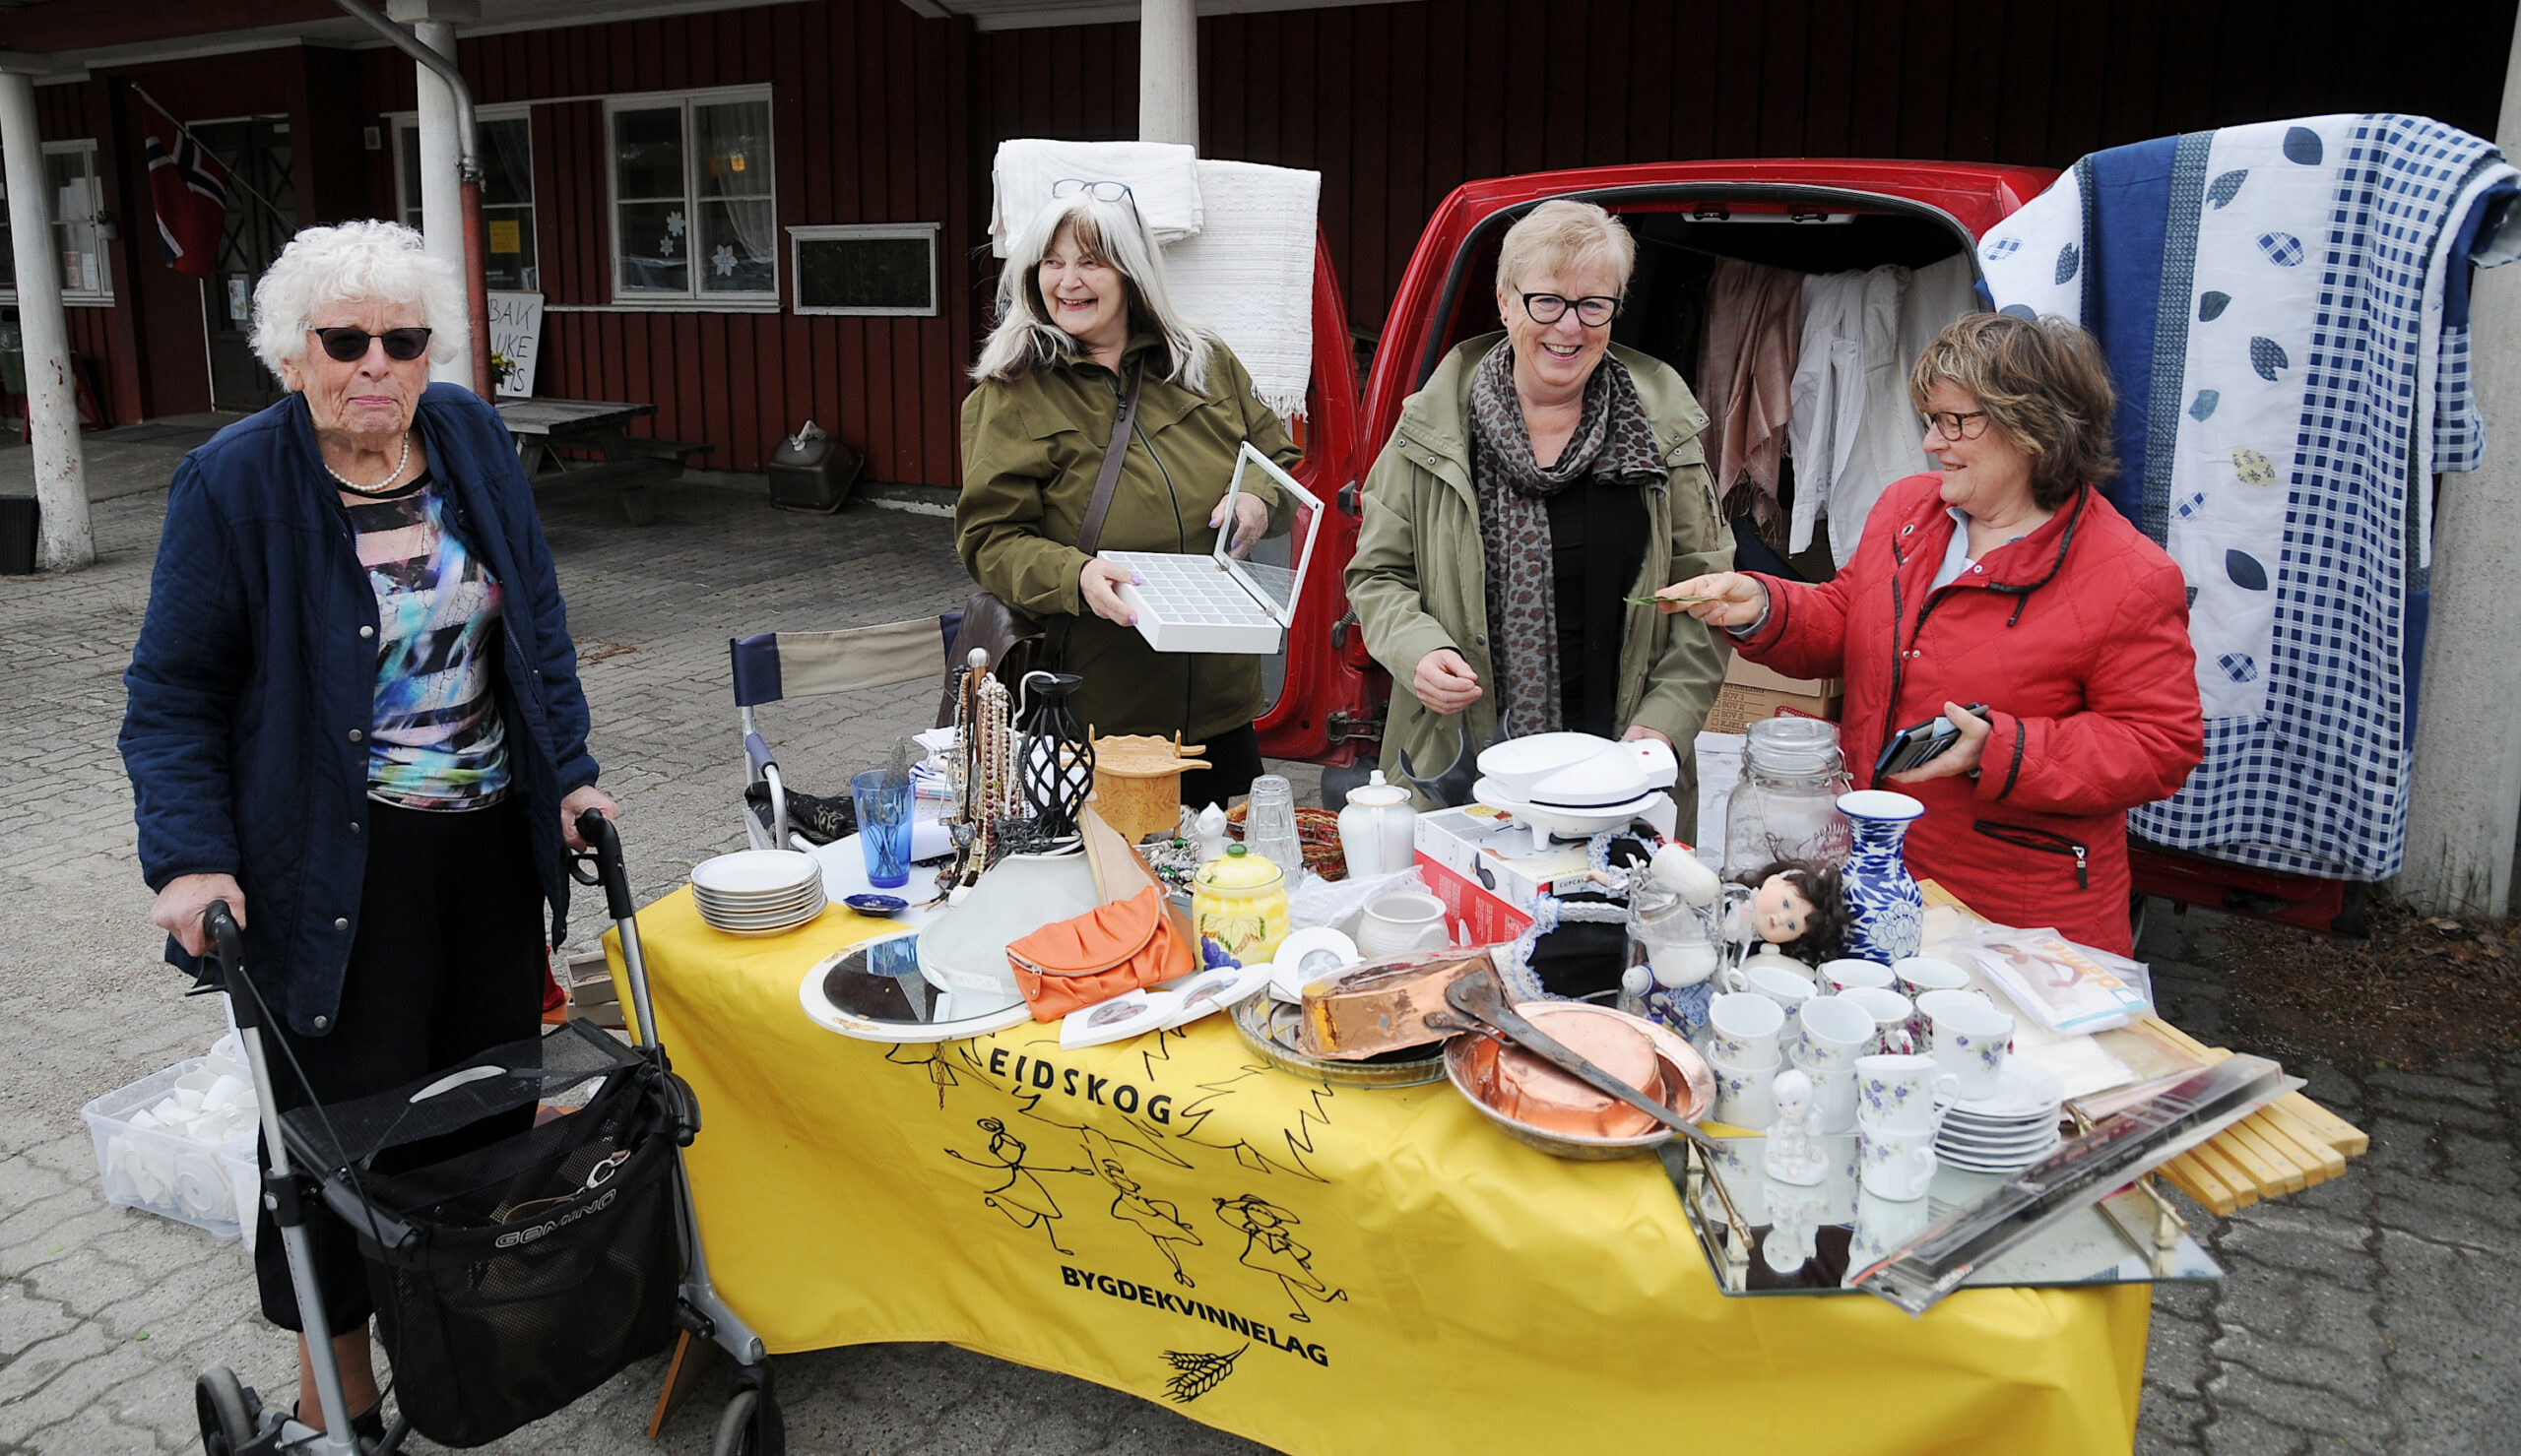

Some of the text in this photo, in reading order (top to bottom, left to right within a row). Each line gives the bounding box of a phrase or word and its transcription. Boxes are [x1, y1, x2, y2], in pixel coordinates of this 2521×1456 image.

[489, 298, 535, 331] BAK
[495, 333, 534, 358] UKE
[990, 1047, 1172, 1125] EIDSKOG
[495, 1188, 616, 1248] GEMINO
[1061, 1265, 1329, 1367] BYGDEKVINNELAG
